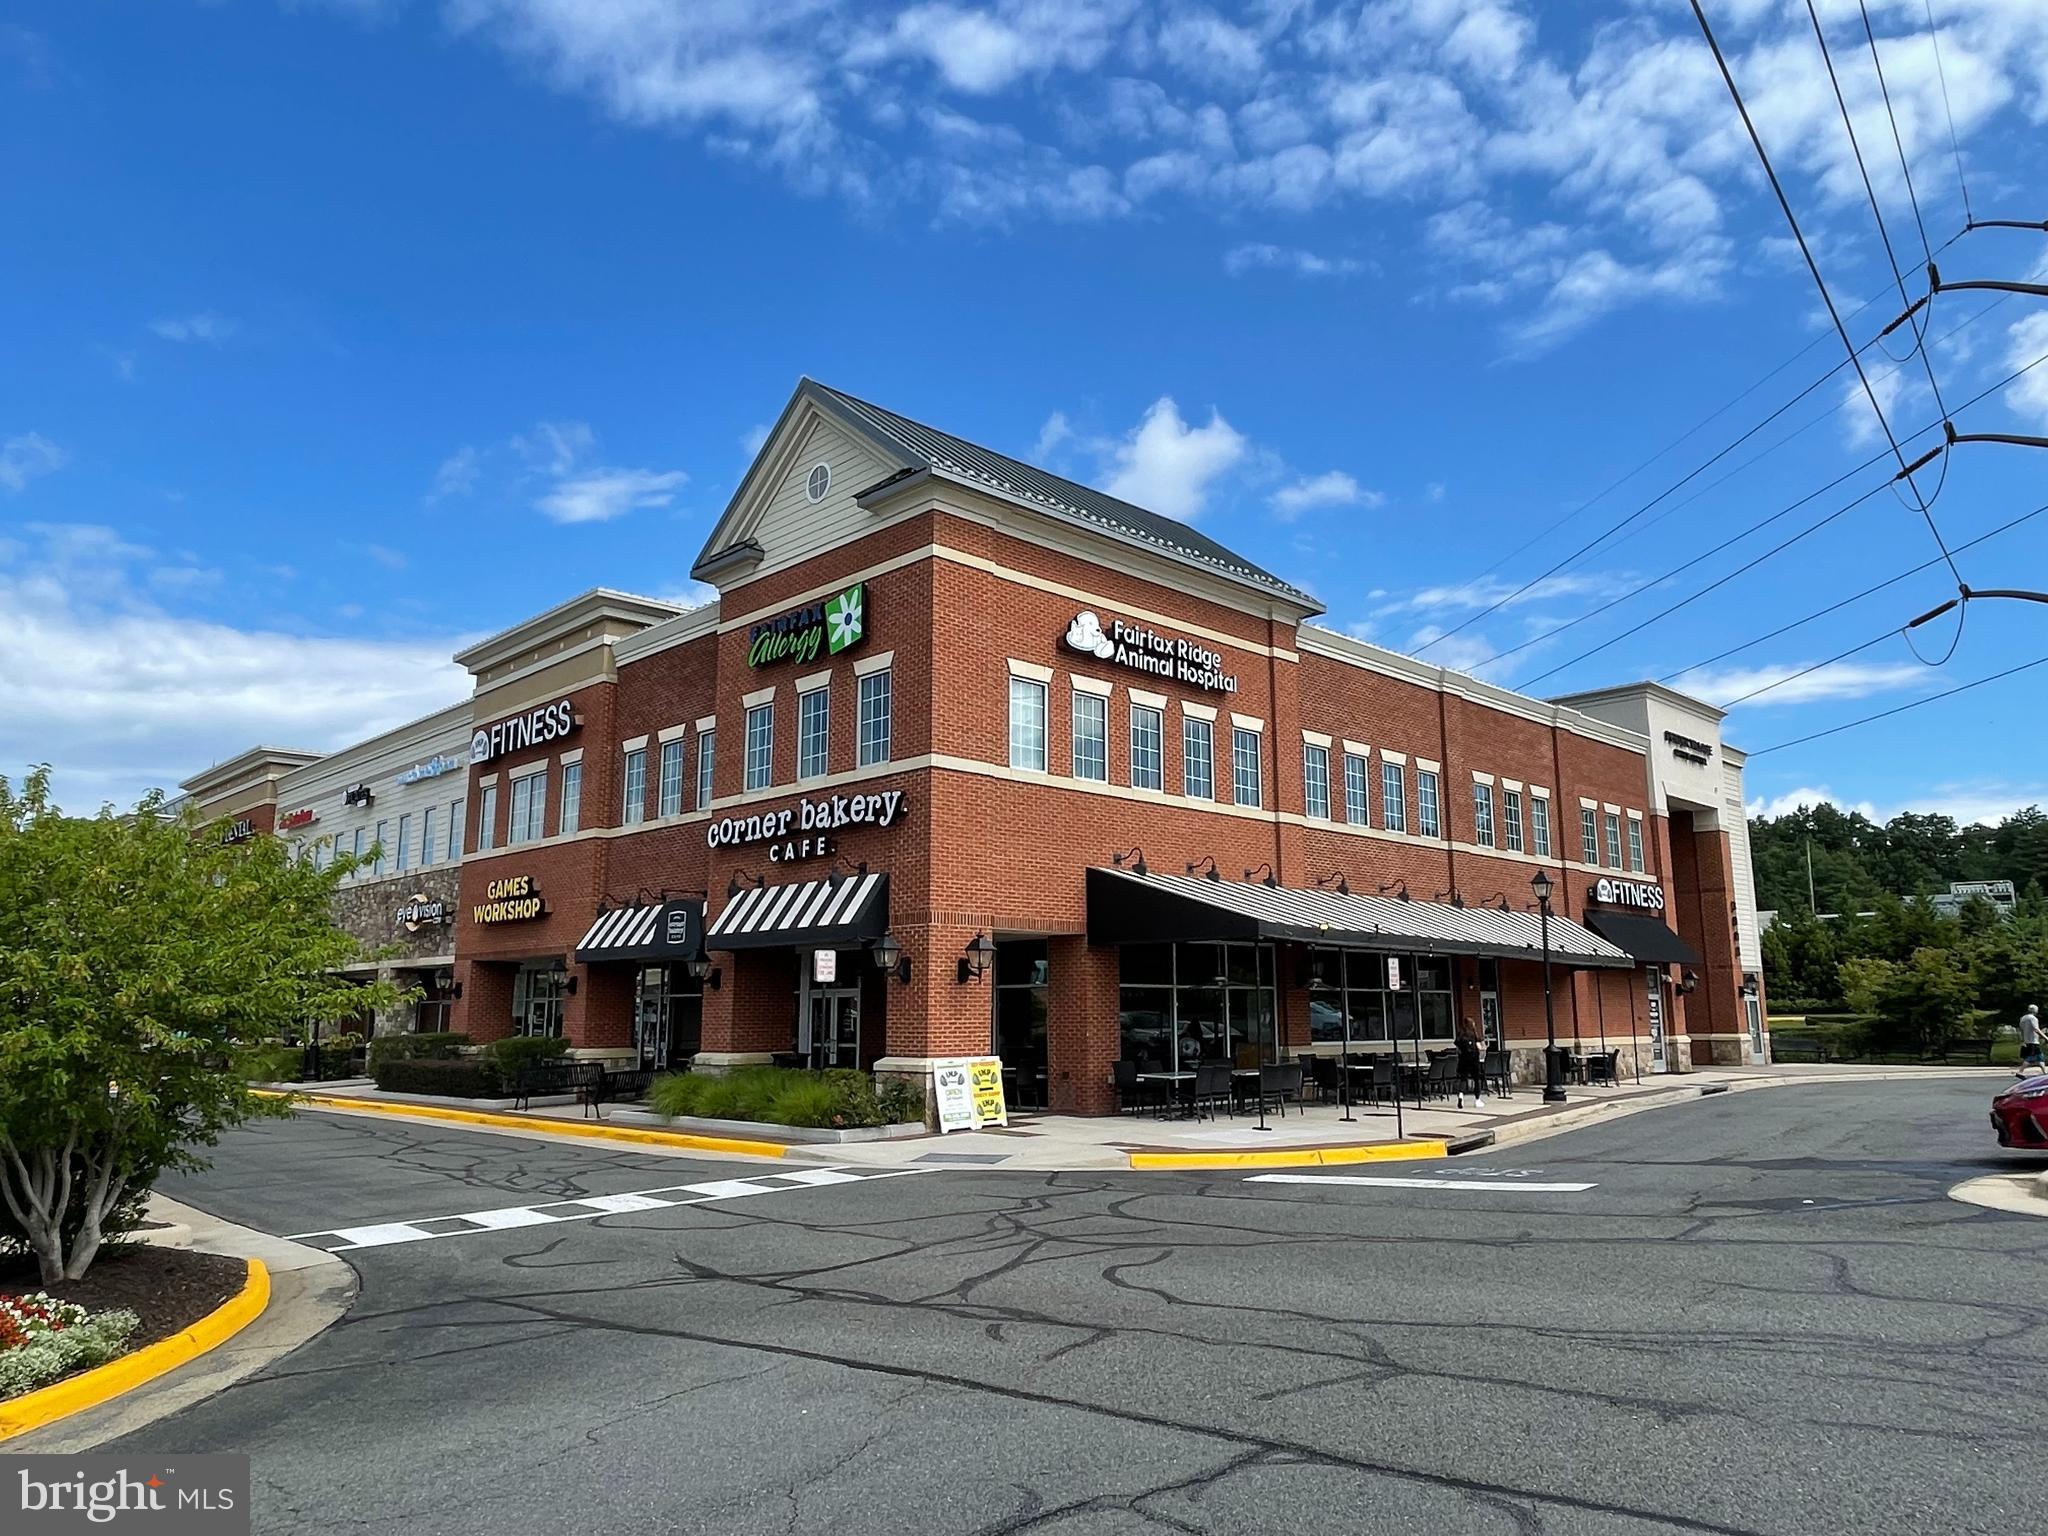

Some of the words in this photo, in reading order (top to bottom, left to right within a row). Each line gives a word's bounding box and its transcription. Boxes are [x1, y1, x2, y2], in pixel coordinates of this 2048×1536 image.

[1114, 620, 1175, 656] Fairfax
[1178, 638, 1222, 669] Ridge
[1114, 643, 1173, 677] Animal
[1177, 660, 1238, 693] Hospital
[490, 700, 571, 758] FITNESS
[707, 809, 791, 848] corner
[801, 791, 901, 830] bakery
[769, 837, 825, 862] CAFE
[487, 875, 529, 900] GAMES
[1611, 880, 1664, 910] FITNESS
[473, 897, 541, 924] WORKSHOP
